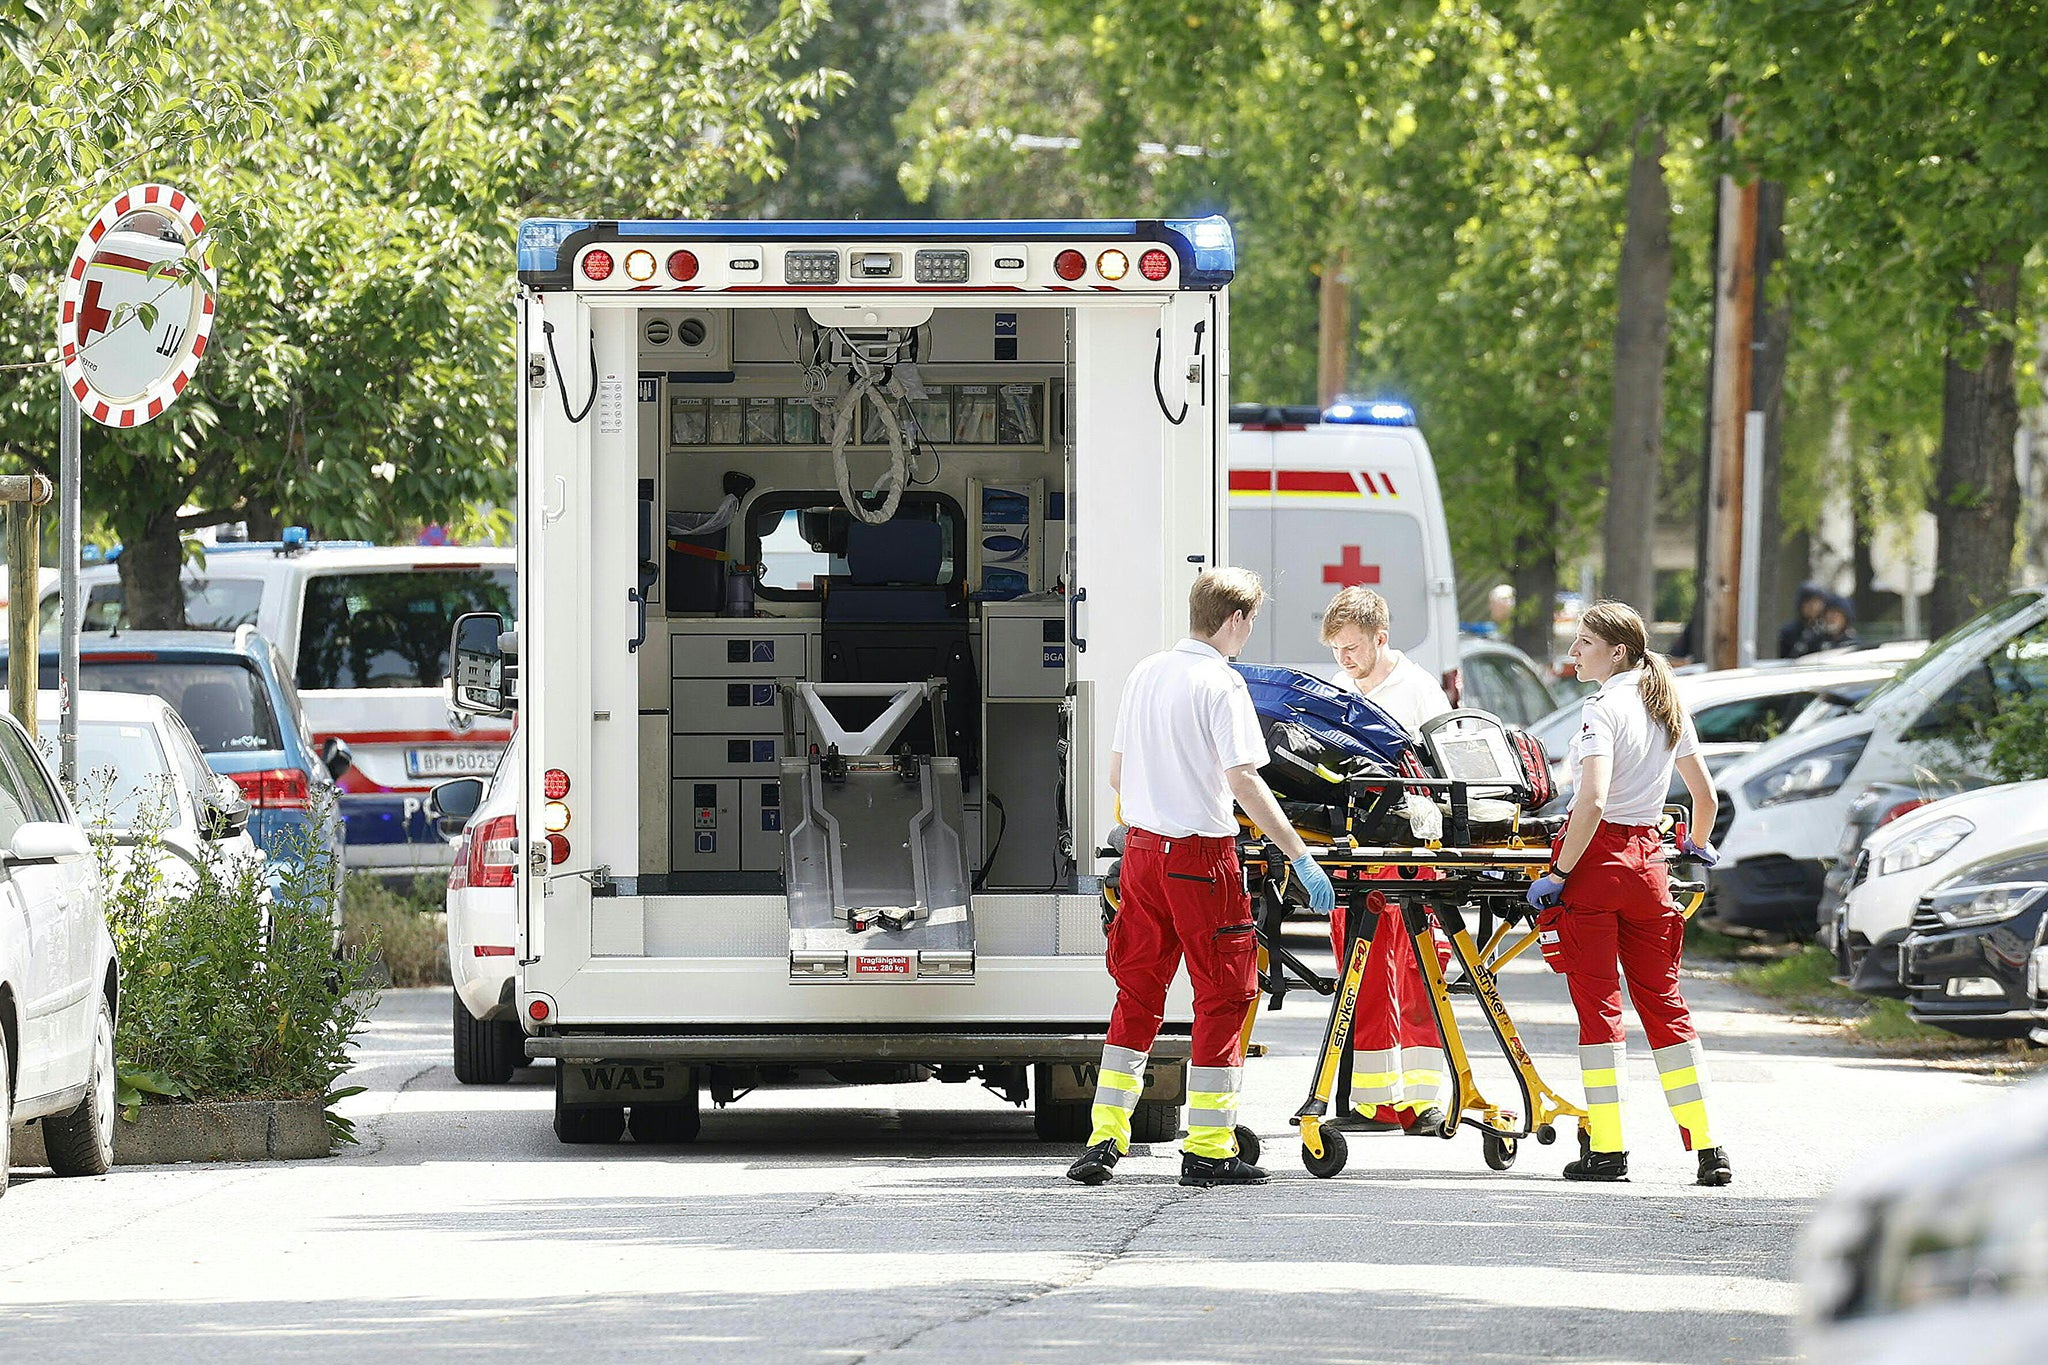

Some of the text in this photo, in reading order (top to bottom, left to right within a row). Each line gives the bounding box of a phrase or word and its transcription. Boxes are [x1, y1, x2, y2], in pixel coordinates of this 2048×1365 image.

[1043, 652, 1064, 662] BGA
[423, 752, 502, 770] BP 6025
[1474, 964, 1506, 1017] stryker
[1334, 987, 1356, 1050] stryker
[581, 1067, 665, 1090] WAS
